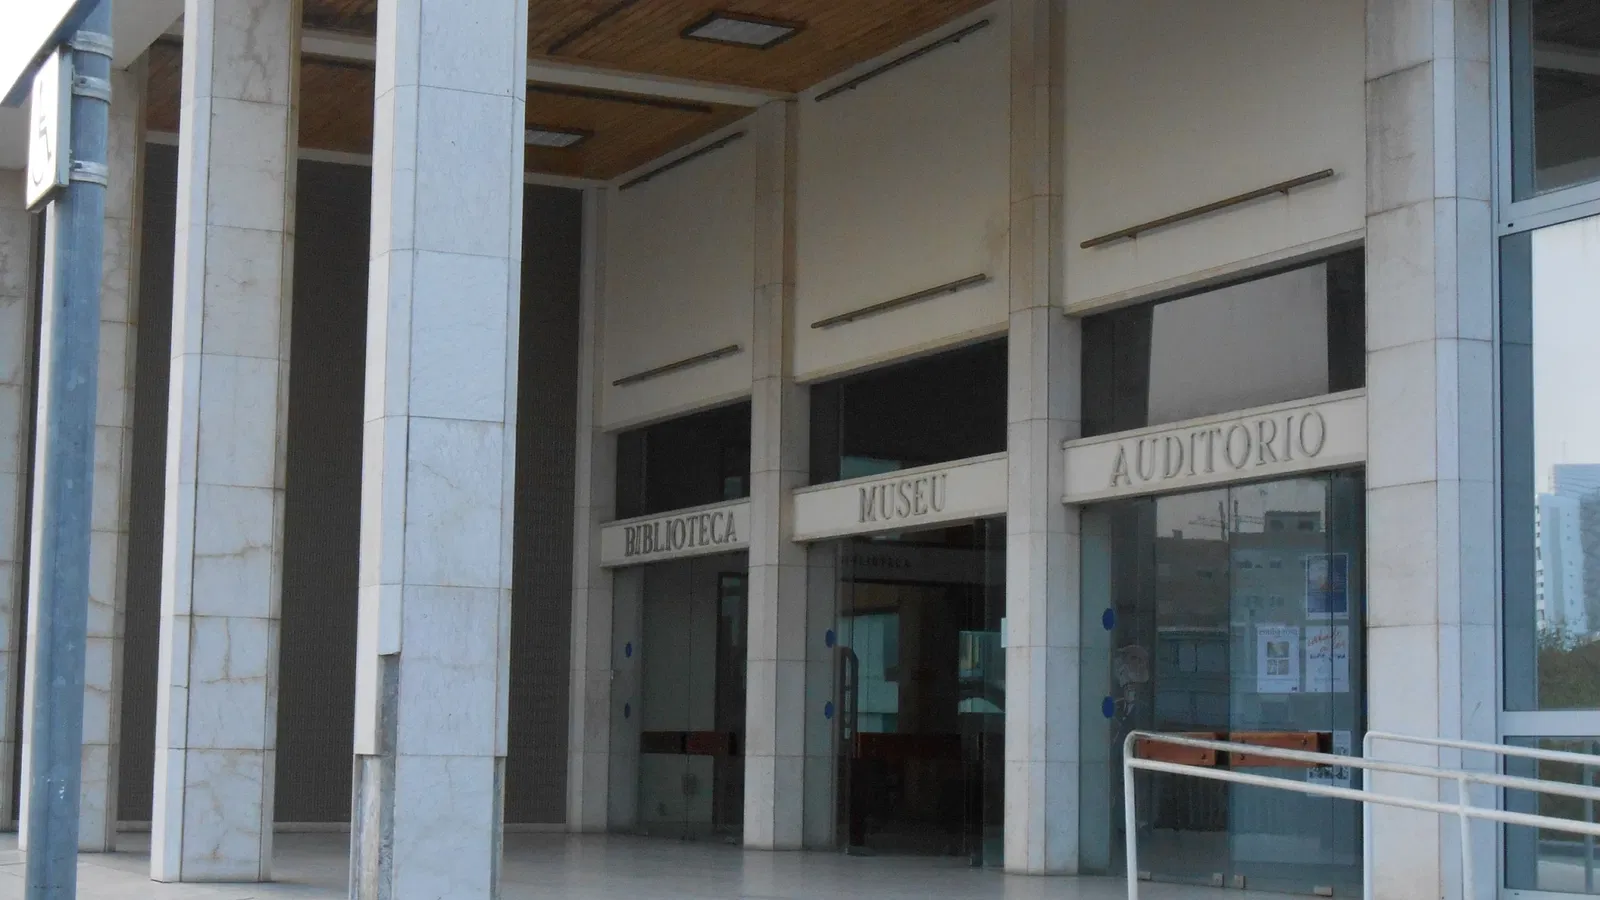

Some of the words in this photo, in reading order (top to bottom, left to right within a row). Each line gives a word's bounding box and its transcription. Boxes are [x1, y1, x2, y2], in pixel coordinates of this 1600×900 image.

[1109, 411, 1327, 487] AUDITORIO
[858, 473, 948, 524] MUSEU
[624, 511, 738, 557] BIBLIOTECA
